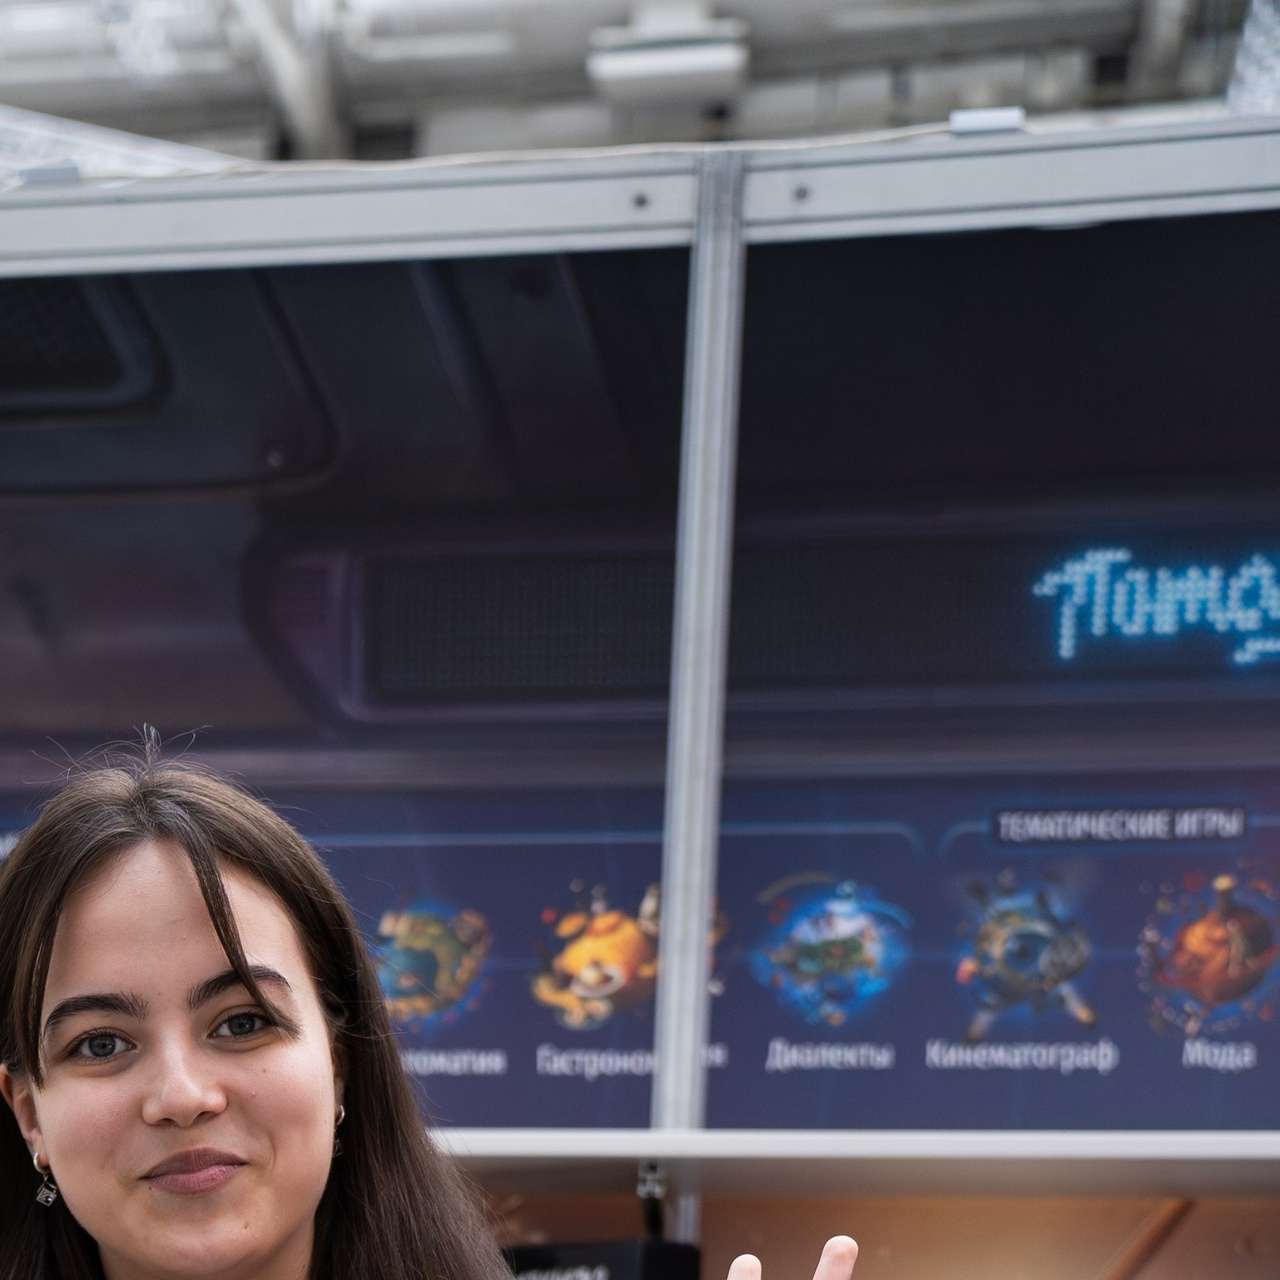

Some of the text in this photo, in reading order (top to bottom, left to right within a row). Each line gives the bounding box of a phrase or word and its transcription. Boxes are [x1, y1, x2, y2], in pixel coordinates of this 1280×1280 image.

[999, 808, 1246, 842] ТЕМАТИЧЕСКИЕ ИГРЫ
[765, 1037, 895, 1073] Диалекты
[925, 1037, 1120, 1075] Кинематограф
[1182, 1037, 1257, 1073] Мода
